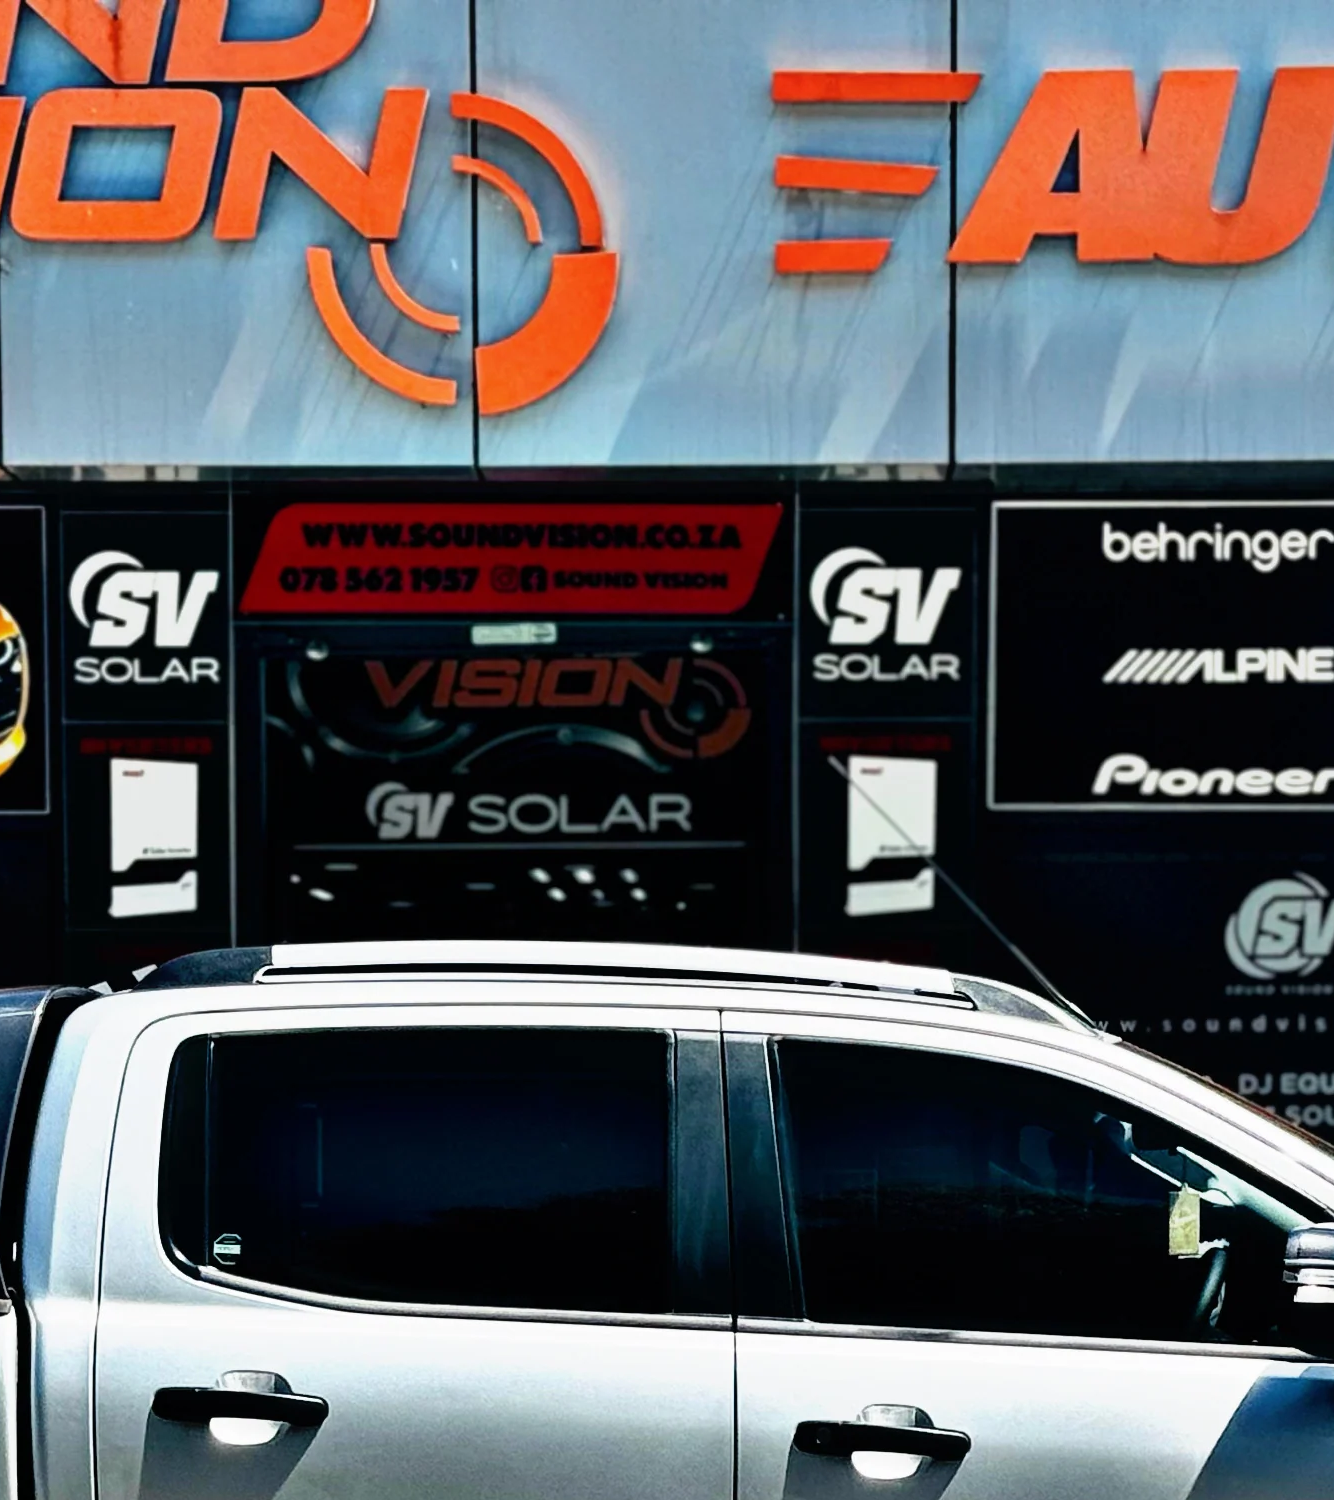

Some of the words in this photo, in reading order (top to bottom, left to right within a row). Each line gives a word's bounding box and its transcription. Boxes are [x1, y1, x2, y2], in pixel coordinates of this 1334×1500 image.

[303, 523, 742, 549] WWW.SOUNDVISION.CO.ZA
[280, 568, 337, 593] 078
[346, 568, 400, 593] 562
[411, 567, 479, 592] 1957
[555, 571, 636, 589] SOUND
[646, 571, 729, 588] VISION
[87, 571, 220, 647] SV
[827, 567, 962, 645] SV
[74, 655, 220, 684] SOLAR
[812, 652, 961, 682] SOLAR
[364, 657, 685, 709] VISION
[377, 790, 455, 840] SV
[467, 792, 694, 834] SOLAR
[1238, 1073, 1272, 1096] DJ
